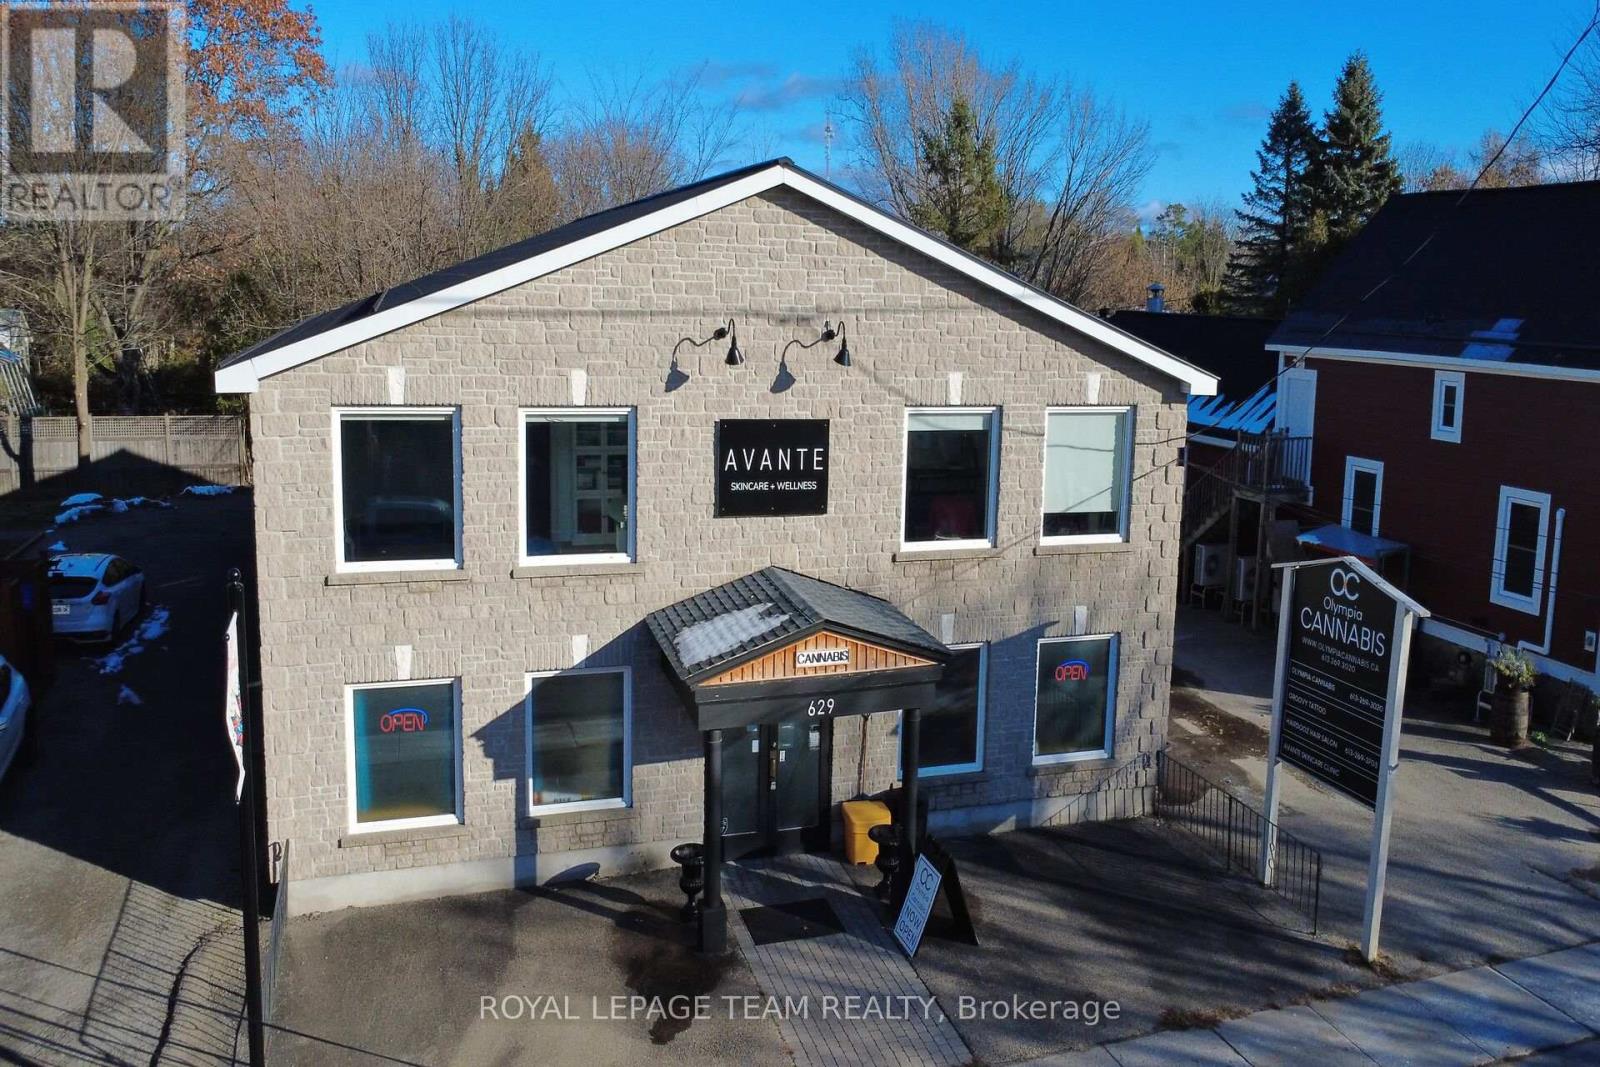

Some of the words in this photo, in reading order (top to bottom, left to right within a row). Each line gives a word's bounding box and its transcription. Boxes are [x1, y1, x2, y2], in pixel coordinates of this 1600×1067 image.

[725, 448, 824, 471] AVANTE
[730, 481, 769, 491] SKINCARE
[777, 481, 817, 491] WELLNESS
[1323, 596, 1363, 621] Olympia
[1300, 607, 1385, 657] CANNABIS
[797, 651, 849, 664] CANNABIS
[1055, 665, 1087, 681] OPEN
[808, 698, 835, 716] 629
[380, 713, 425, 733] OPEN
[905, 905, 921, 929] NOW
[900, 920, 916, 945] OPEN
